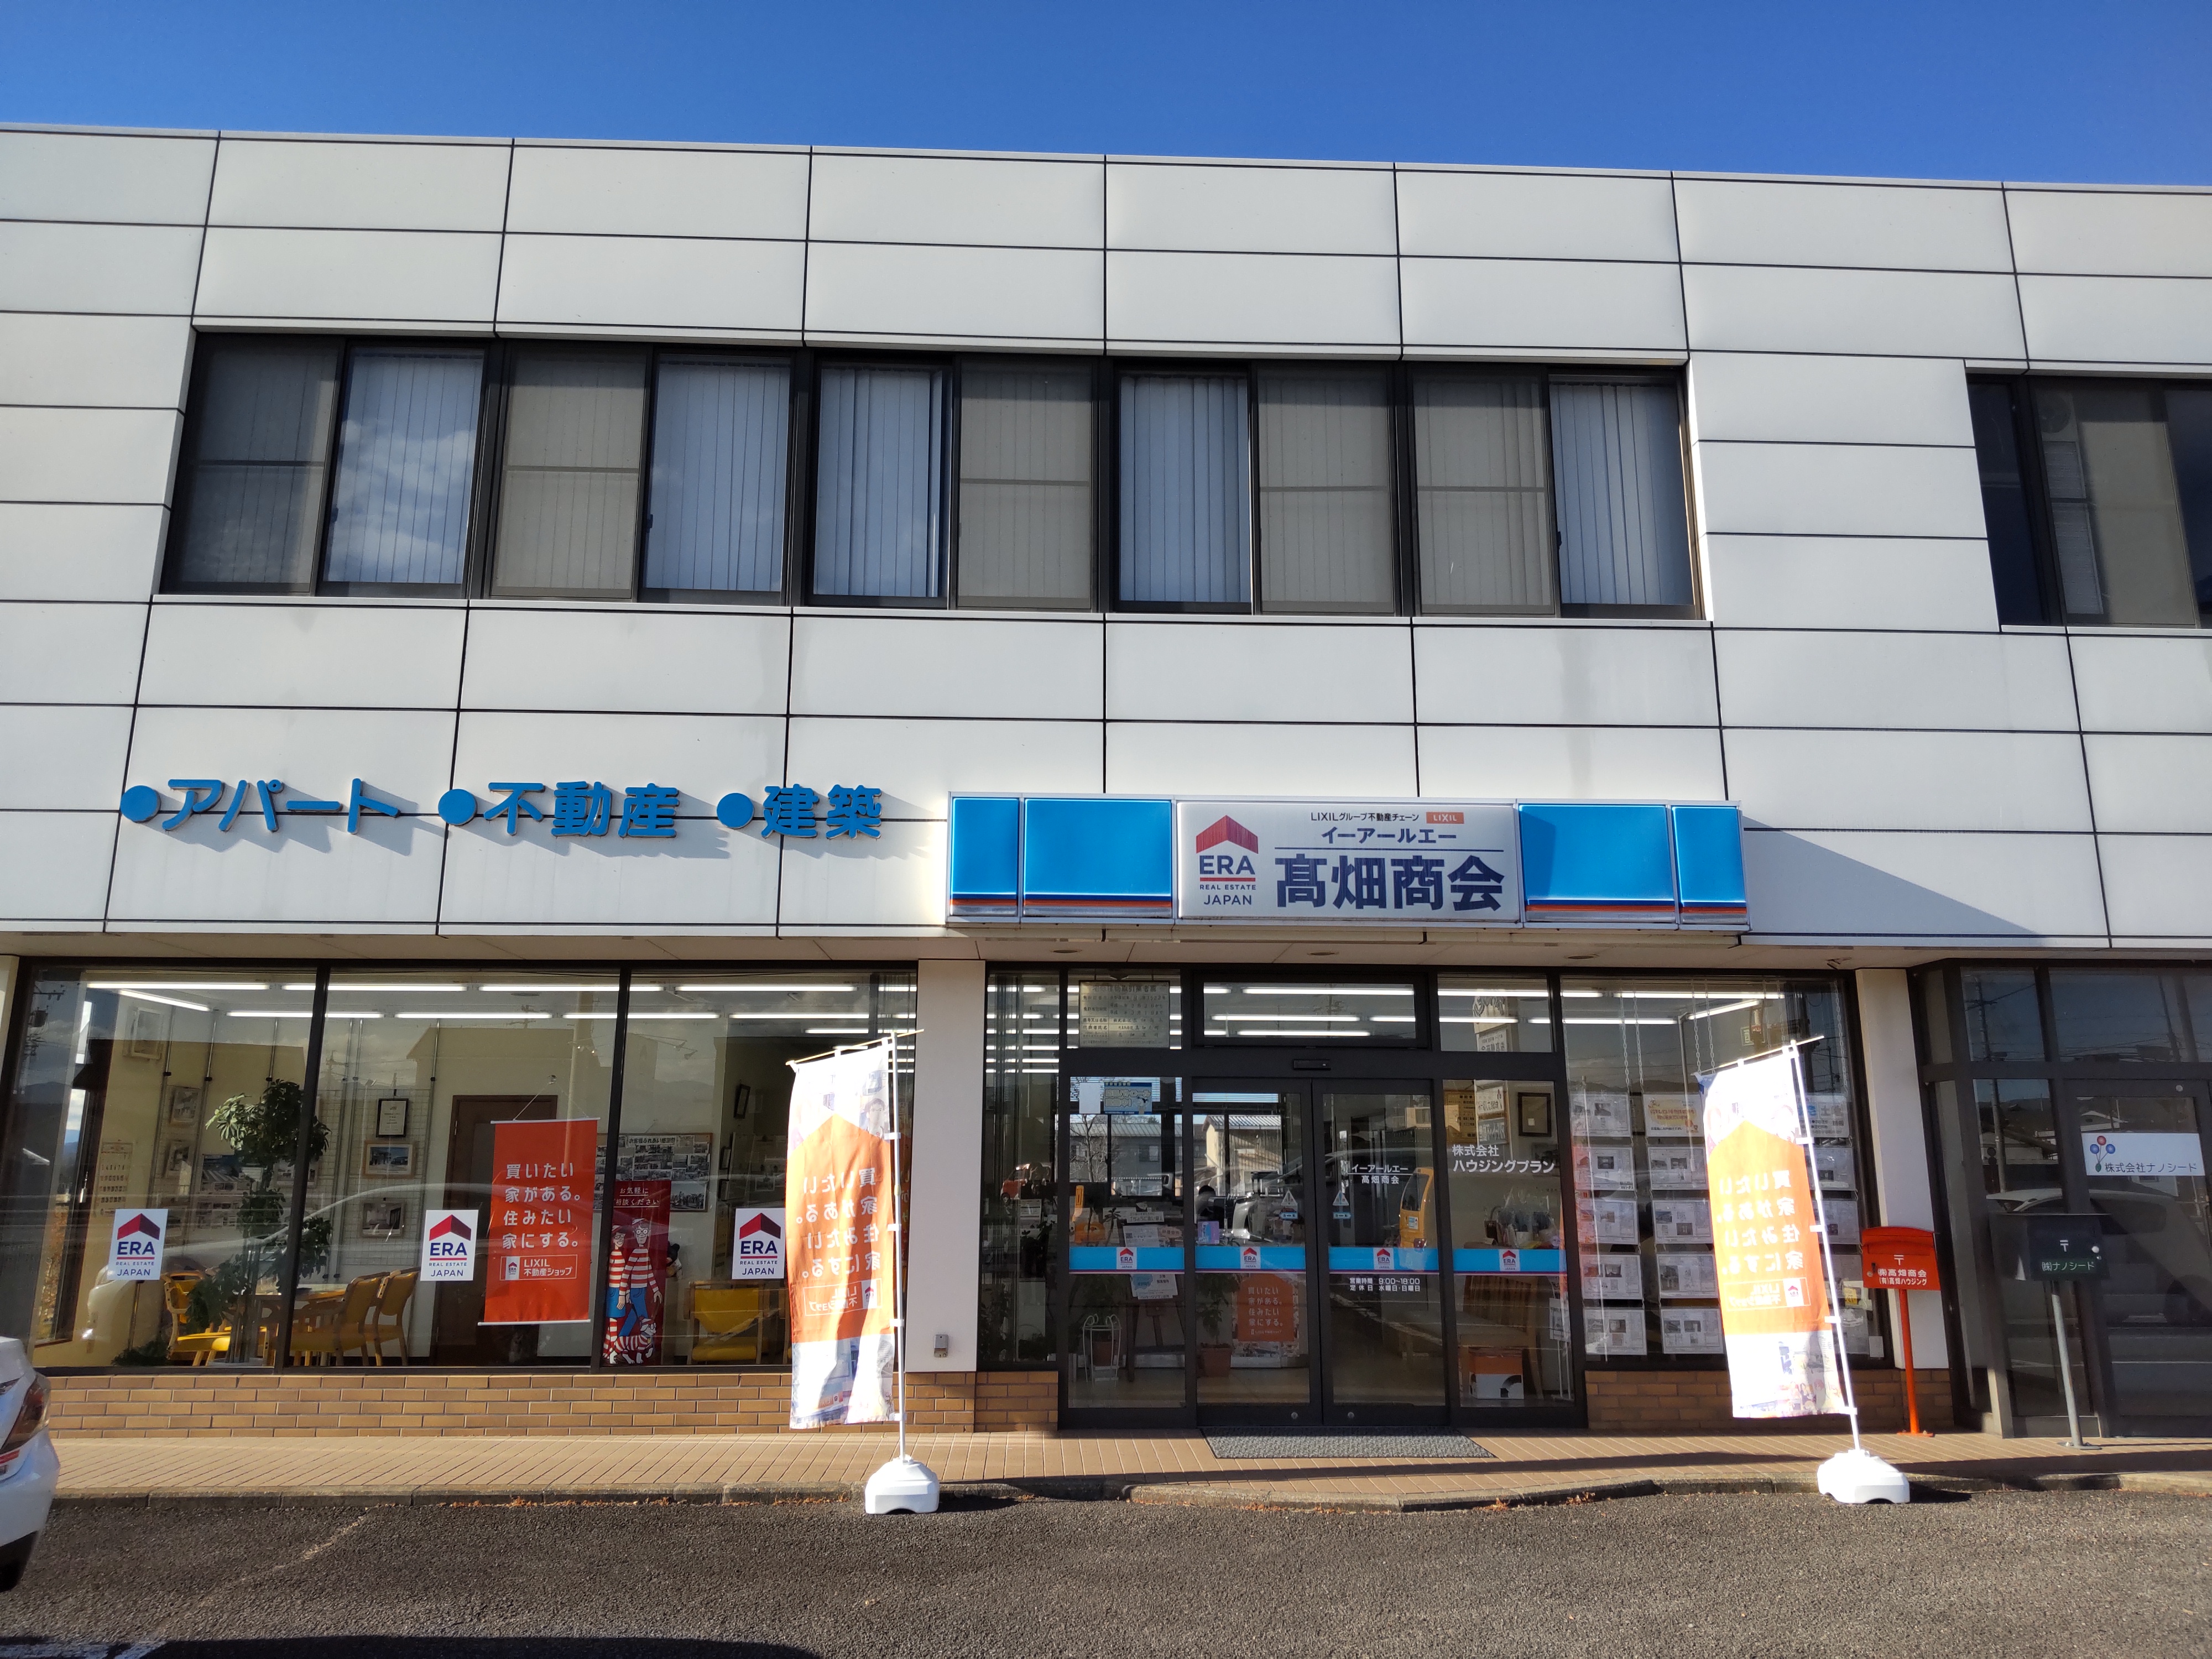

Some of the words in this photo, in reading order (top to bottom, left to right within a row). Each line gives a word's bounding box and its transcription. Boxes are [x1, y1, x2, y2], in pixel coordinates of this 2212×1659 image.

[162, 778, 400, 834] アパート
[483, 780, 680, 838] 不動産
[760, 784, 883, 839] 建築
[1311, 812, 1419, 822] LIXILグループ不動産チェーン
[1322, 826, 1457, 844] イーアールエー
[1199, 855, 1256, 875] ERA
[1204, 895, 1251, 905] JAPAN
[1452, 1145, 1499, 1156] 株式会社
[506, 1162, 573, 1179] 買いたい
[1351, 1164, 1408, 1173] イーアールエー
[1453, 1160, 1554, 1173] ハウジングプラン
[2105, 1162, 2197, 1173] 株式会社ナノシード
[505, 1186, 580, 1203] 家がある。
[504, 1209, 571, 1225] 住みたい
[502, 1232, 578, 1249] 家にする。
[740, 1240, 778, 1254] ERA
[117, 1241, 155, 1255] ERA
[430, 1243, 467, 1256] ERA
[524, 1266, 572, 1276] 不動産ショップ
[1248, 1297, 1282, 1306] 家がある。
[1249, 1318, 1283, 1327] 家にする。
